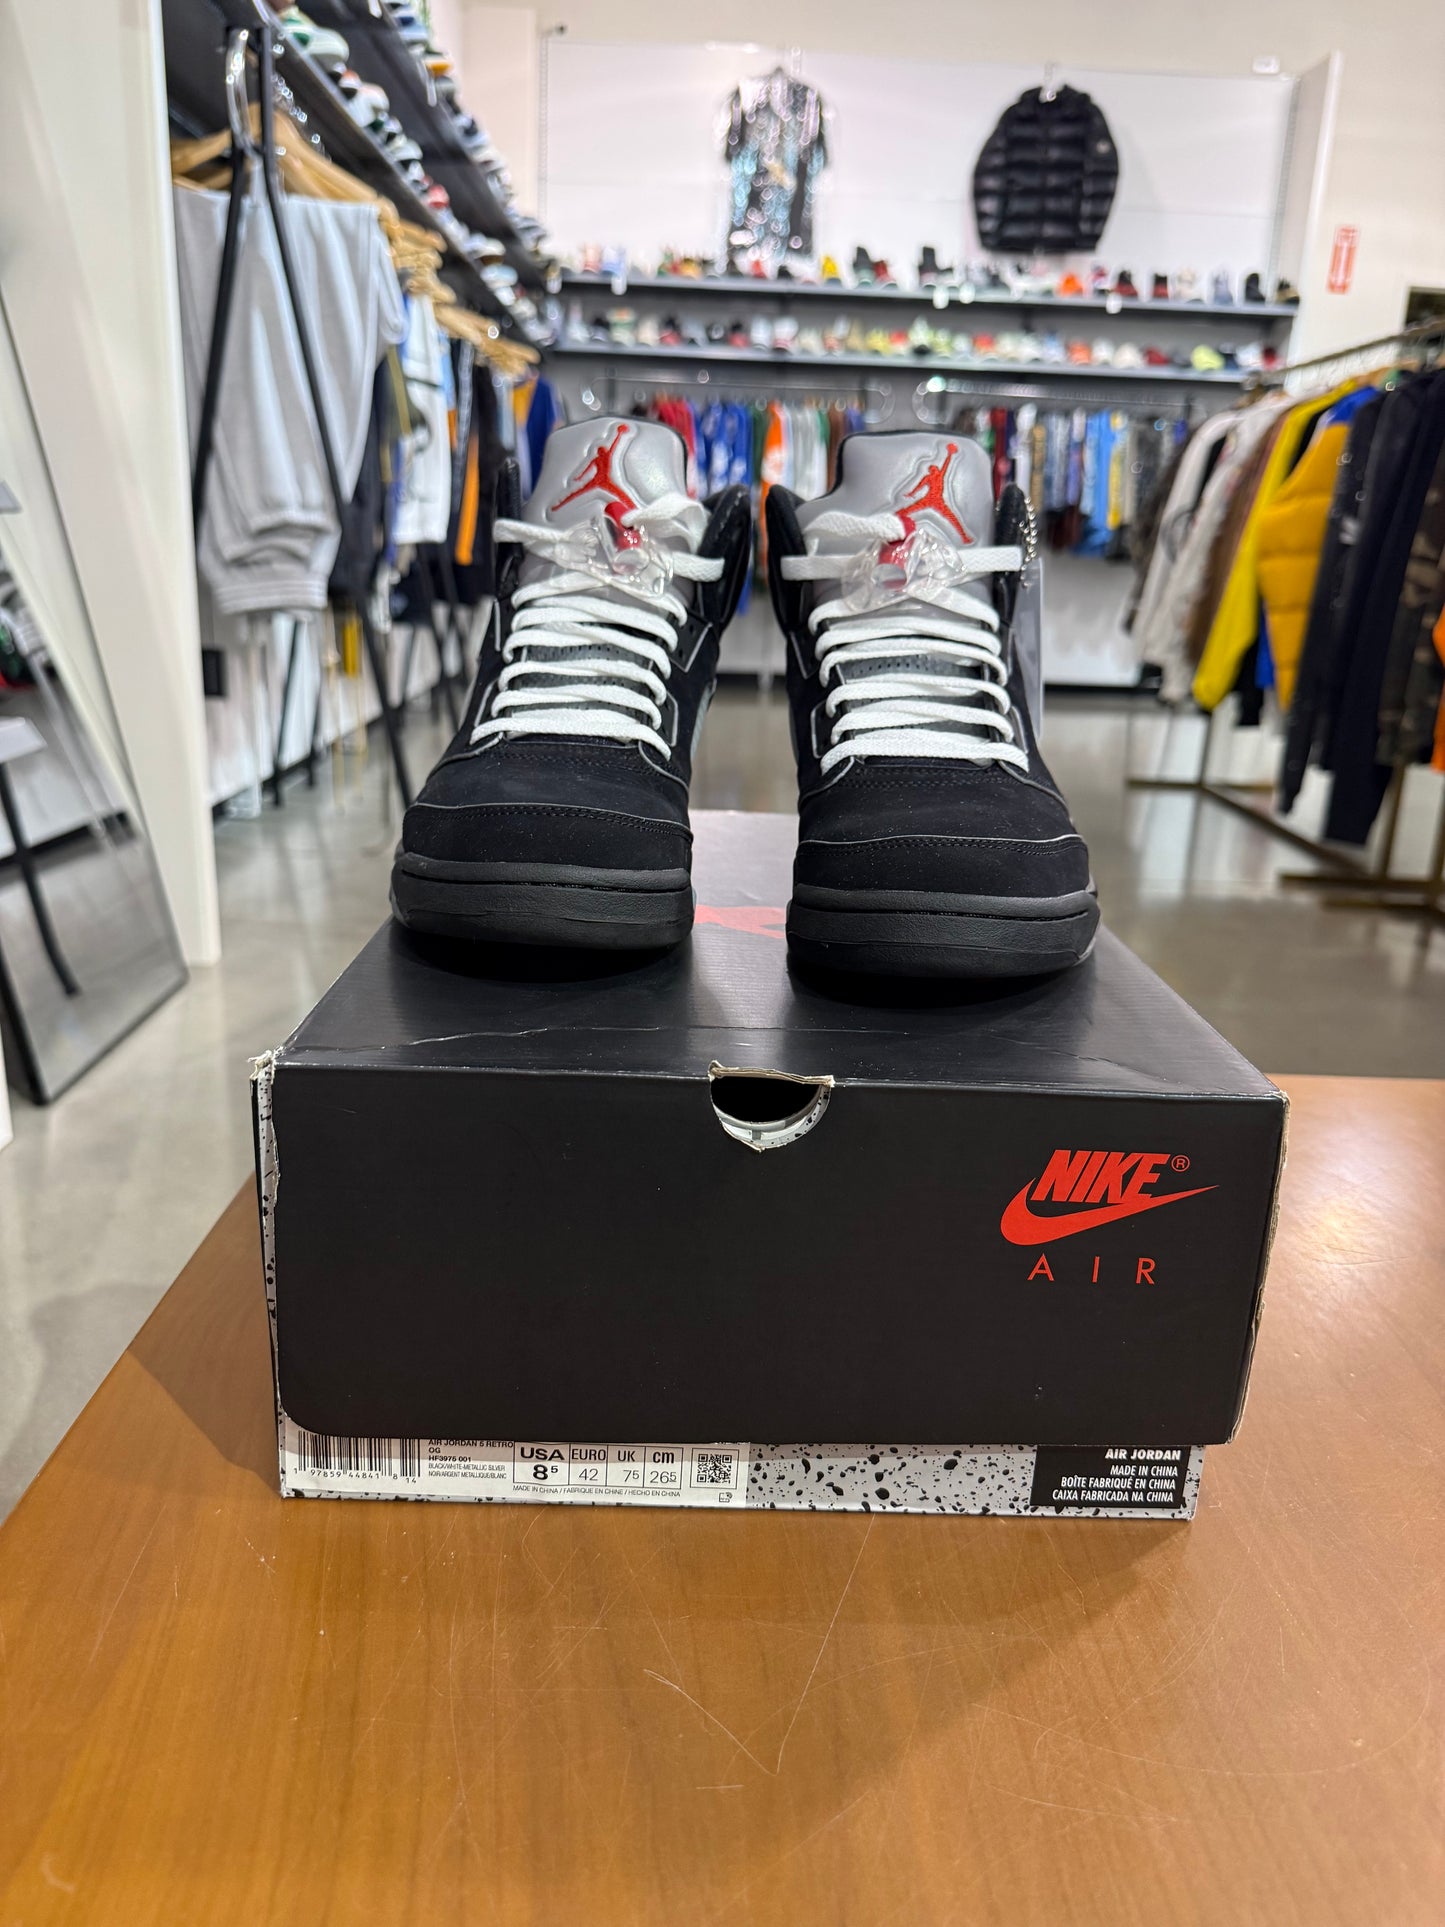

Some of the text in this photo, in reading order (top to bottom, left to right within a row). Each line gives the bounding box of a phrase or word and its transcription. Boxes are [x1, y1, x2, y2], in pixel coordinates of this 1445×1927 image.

[1030, 1149, 1170, 1204] NIKE
[1027, 1253, 1156, 1284] AIR
[520, 1446, 675, 1464] USA EURO UK cm
[1105, 1448, 1181, 1460] AIR JORDAN
[578, 1468, 599, 1481] 42
[1110, 1465, 1178, 1477] MADE IN CHINA
[1061, 1475, 1087, 1488] BOÎTE
[1134, 1478, 1147, 1489] EN
[1148, 1478, 1176, 1490] CHINA
[539, 1486, 558, 1494] CHINA
[1052, 1489, 1174, 1503] CAIXA FABRICADA NA CHINA
